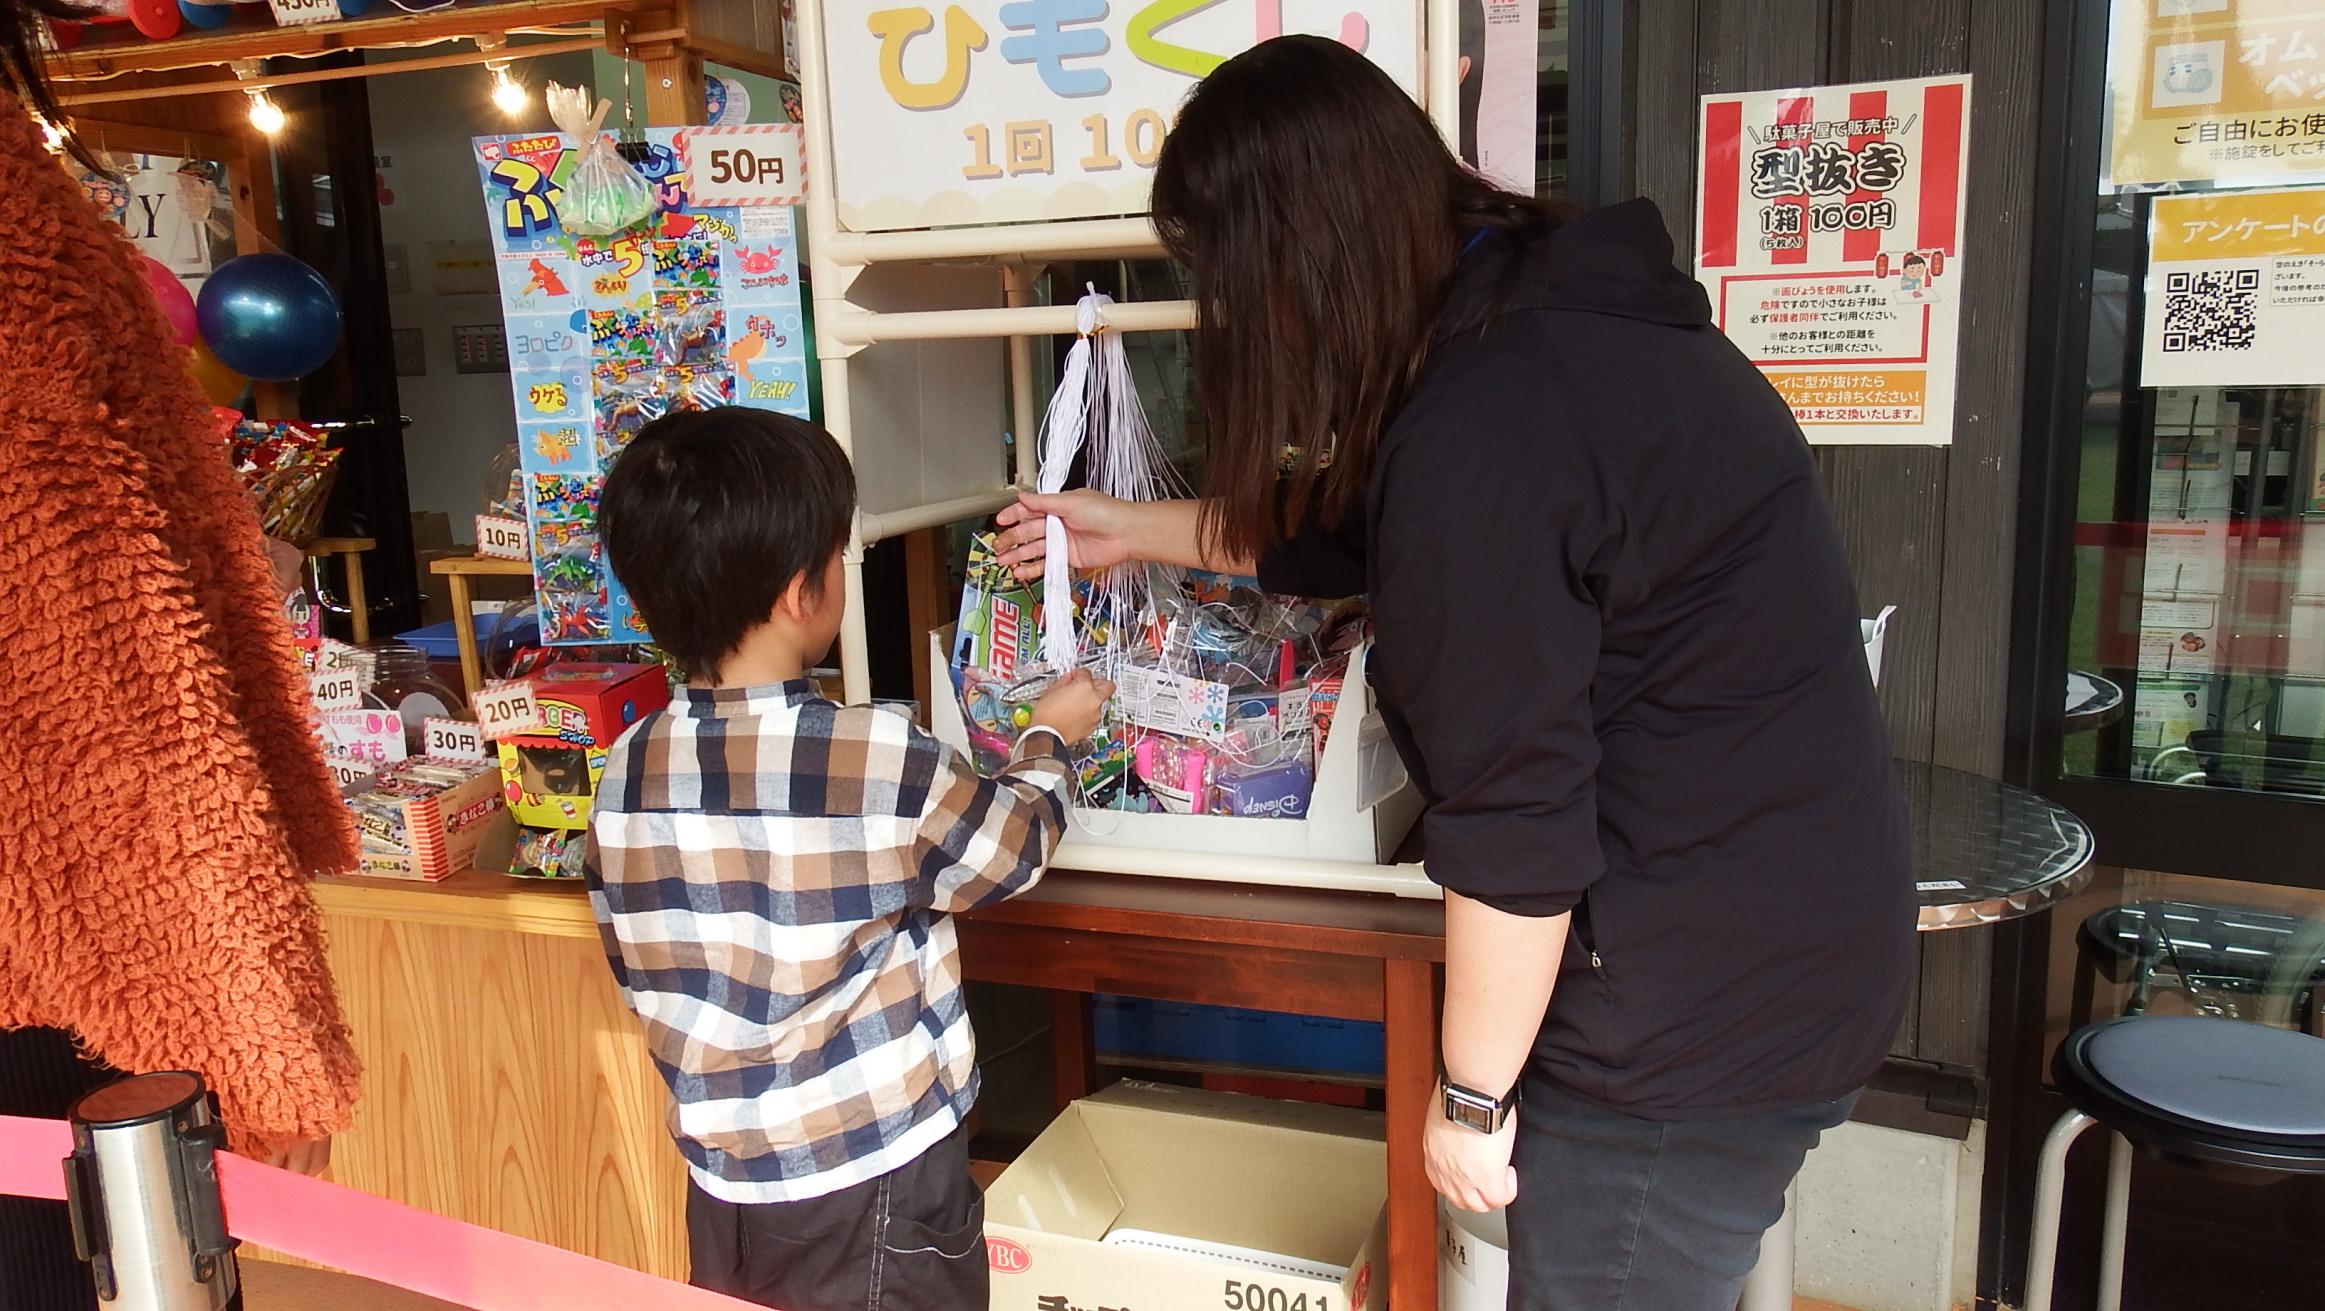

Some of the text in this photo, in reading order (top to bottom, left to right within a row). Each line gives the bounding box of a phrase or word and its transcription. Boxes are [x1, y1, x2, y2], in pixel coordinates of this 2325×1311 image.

[1763, 115, 1900, 143] 駄菓子屋で販売中
[961, 118, 1054, 179] 1回
[710, 148, 784, 185] 50円
[1752, 143, 1905, 197] 型抜き
[1761, 199, 1896, 234] 1箱 100円
[1760, 236, 1804, 250] (5枚入)
[1760, 298, 1887, 310] 危険ですので小さなお子様は
[1750, 311, 1898, 324] 必ず保護者同伴でご利用ください。
[1761, 343, 1884, 355] 十分にとってご利用ください。
[529, 387, 568, 407] ウケる
[749, 379, 797, 400] YEAH!
[485, 528, 521, 550] 10円
[317, 680, 354, 701] 40円
[484, 696, 531, 724] 20円
[433, 729, 476, 753] 30円
[1242, 793, 1303, 818] Disney
